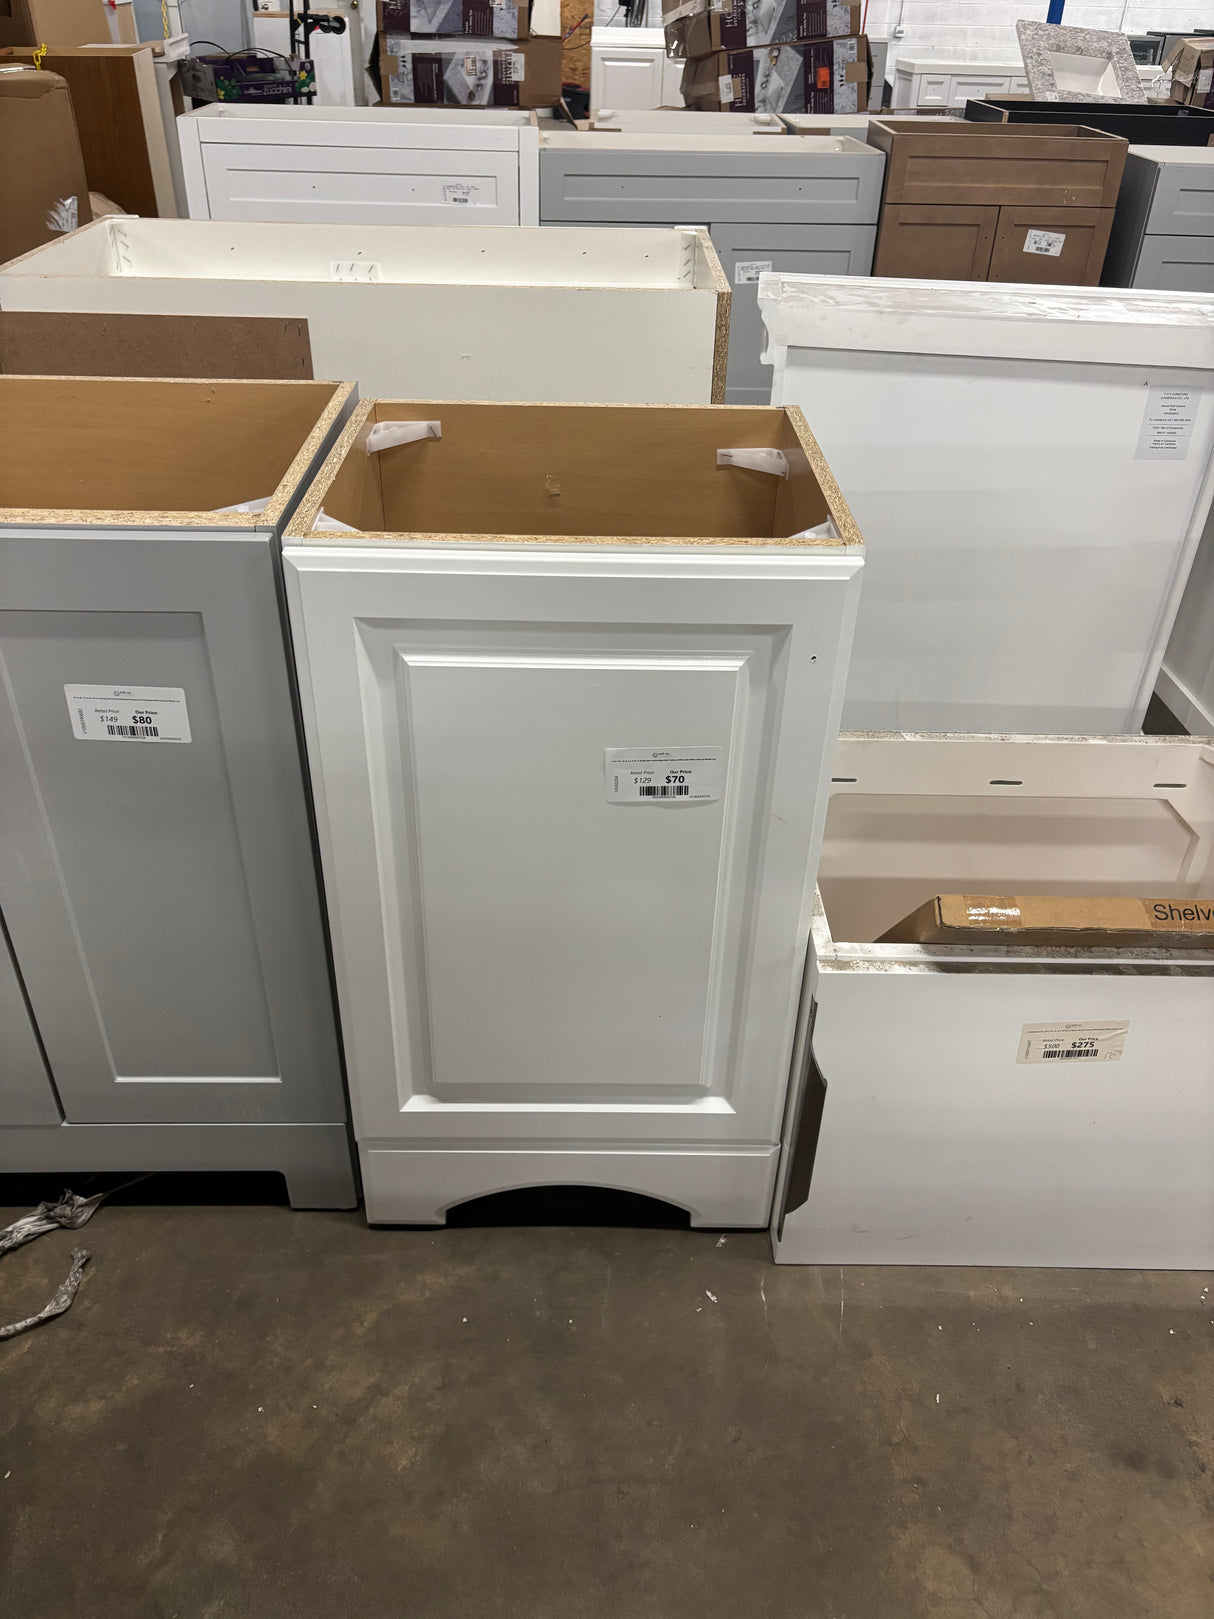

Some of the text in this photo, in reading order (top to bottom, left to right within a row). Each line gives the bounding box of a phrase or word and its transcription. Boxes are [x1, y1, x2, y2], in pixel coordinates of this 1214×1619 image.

[263, 84, 292, 95] zucchini
[100, 715, 152, 725] $149 $80
[665, 775, 685, 784] $70
[1153, 904, 1214, 921] Shelv
[1071, 1041, 1095, 1049] $275
